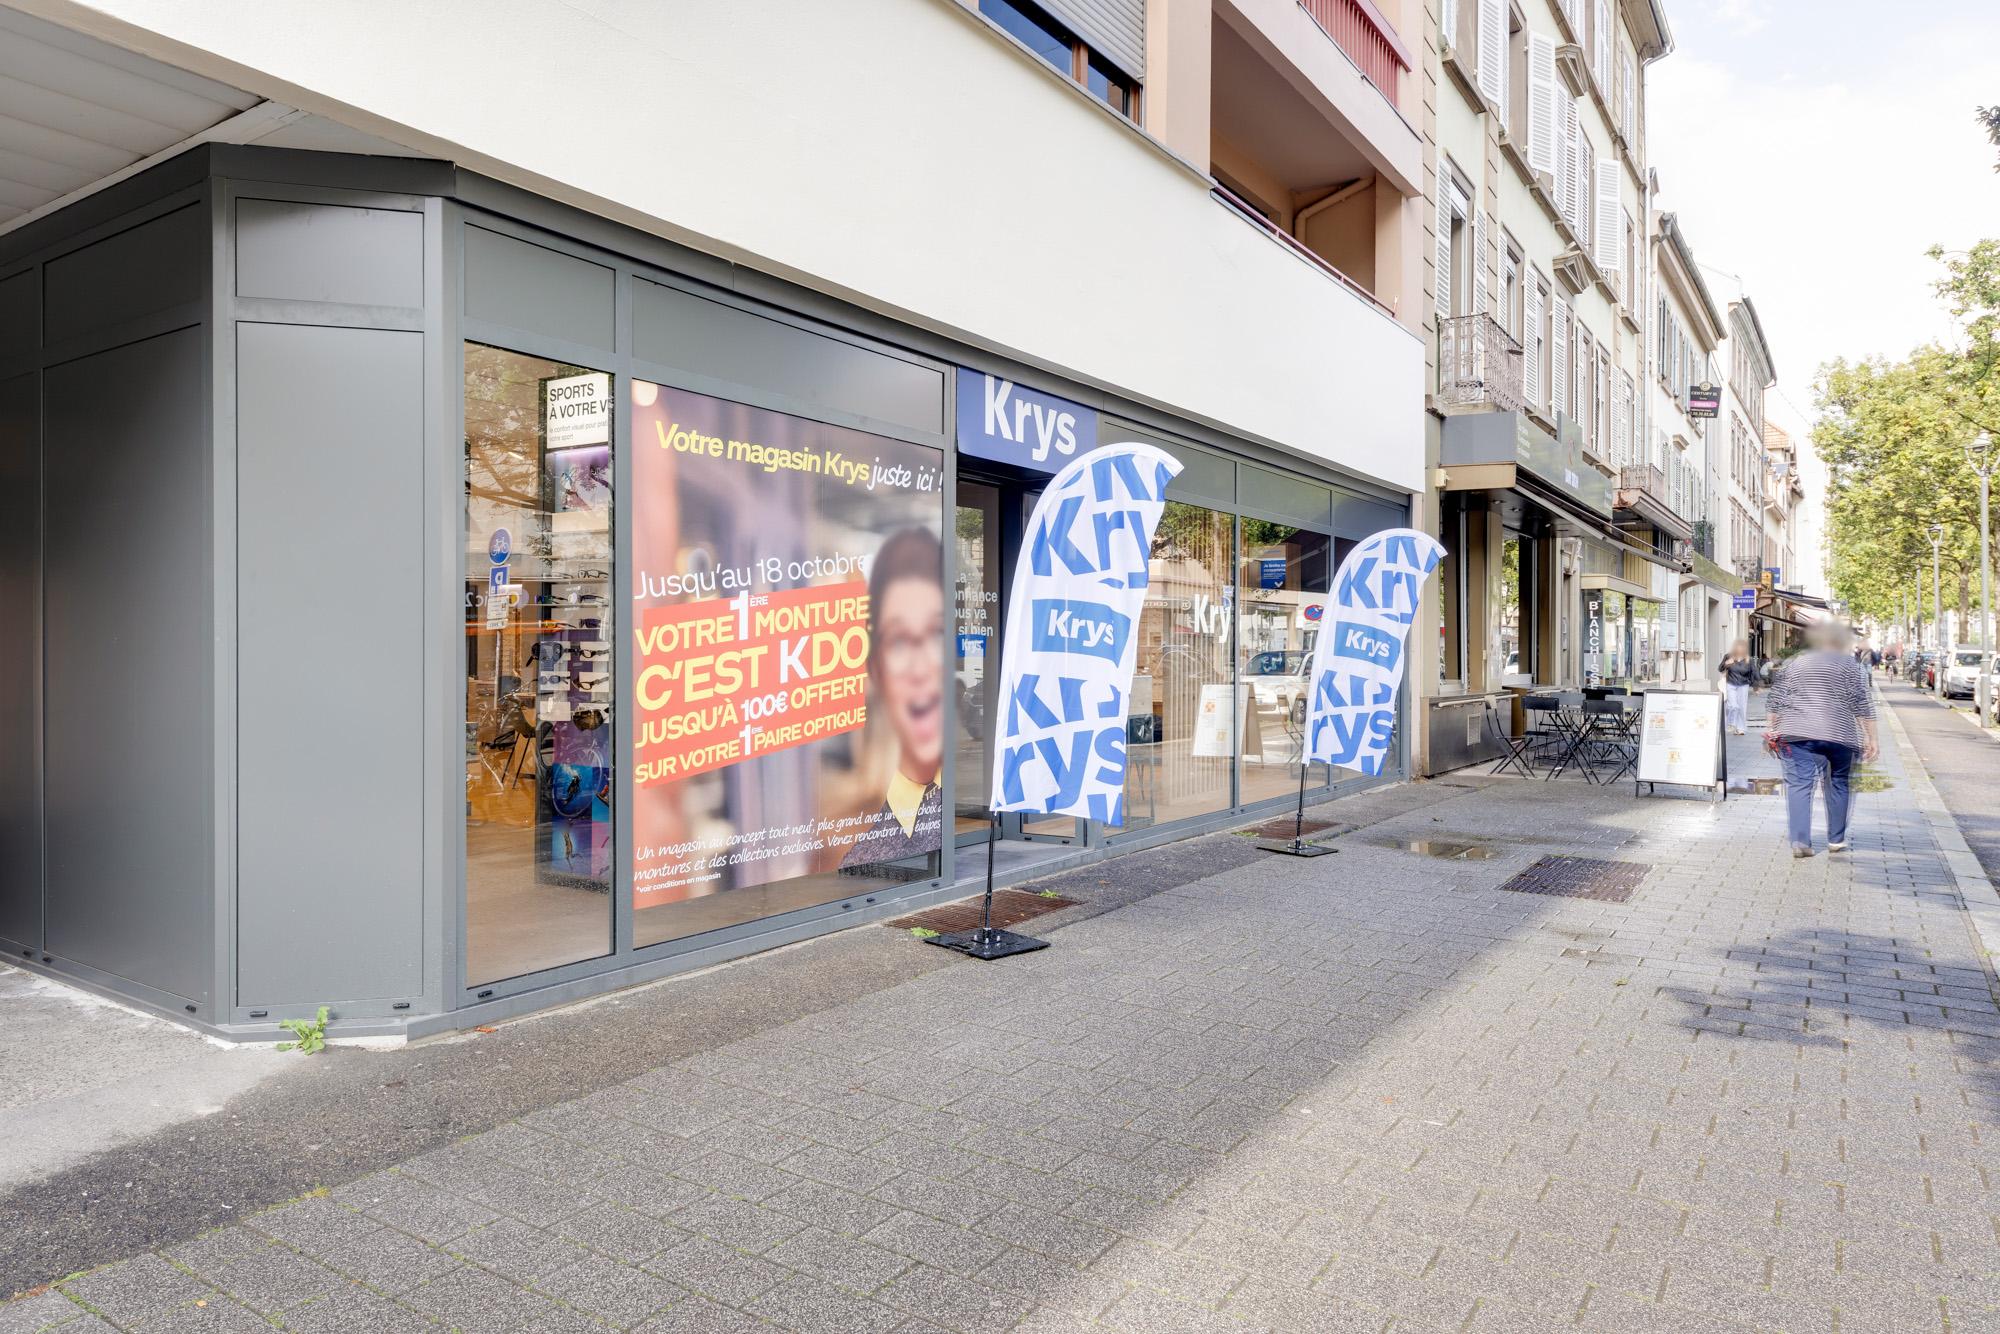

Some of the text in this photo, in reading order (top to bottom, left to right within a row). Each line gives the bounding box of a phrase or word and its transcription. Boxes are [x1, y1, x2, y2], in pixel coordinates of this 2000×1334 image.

[549, 383, 594, 402] SPORTS
[550, 404, 557, 420] À
[560, 401, 597, 418] VOTRE
[985, 375, 1076, 462] Krys
[655, 420, 724, 458] Votre
[727, 440, 821, 473] magasin
[824, 451, 870, 485] Krys
[867, 456, 912, 490] juste
[916, 465, 936, 492] ici
[634, 551, 867, 600] Jusqu'au 18 octobre
[634, 614, 735, 656] VOTRE
[755, 595, 871, 637] MONTURE
[955, 607, 971, 619] us
[971, 622, 993, 636] bien
[1048, 608, 1114, 648] Krys
[1345, 629, 1391, 658] Krys
[636, 645, 768, 711] C'EST
[634, 672, 868, 749] JUSQU'À 100€ OFFERT
[634, 755, 677, 785] SUR
[679, 738, 741, 770] VOTRE
[754, 723, 802, 752] PAIRE
[803, 706, 867, 735] OPTIQUE
[634, 861, 691, 881] montures
[694, 856, 706, 871] et
[708, 852, 727, 869] des
[729, 845, 780, 865] collections
[827, 834, 853, 848] Venez
[854, 825, 899, 843] rencontrer
[636, 846, 655, 860] Un
[658, 837, 706, 858] magasin
[725, 829, 767, 847] concept
[769, 824, 790, 839] tout
[817, 817, 835, 836] plus
[835, 811, 863, 832] grand
[864, 811, 883, 823] avec
[917, 802, 937, 816] choix
[653, 878, 686, 891] conditions
[696, 872, 721, 884] magasin
